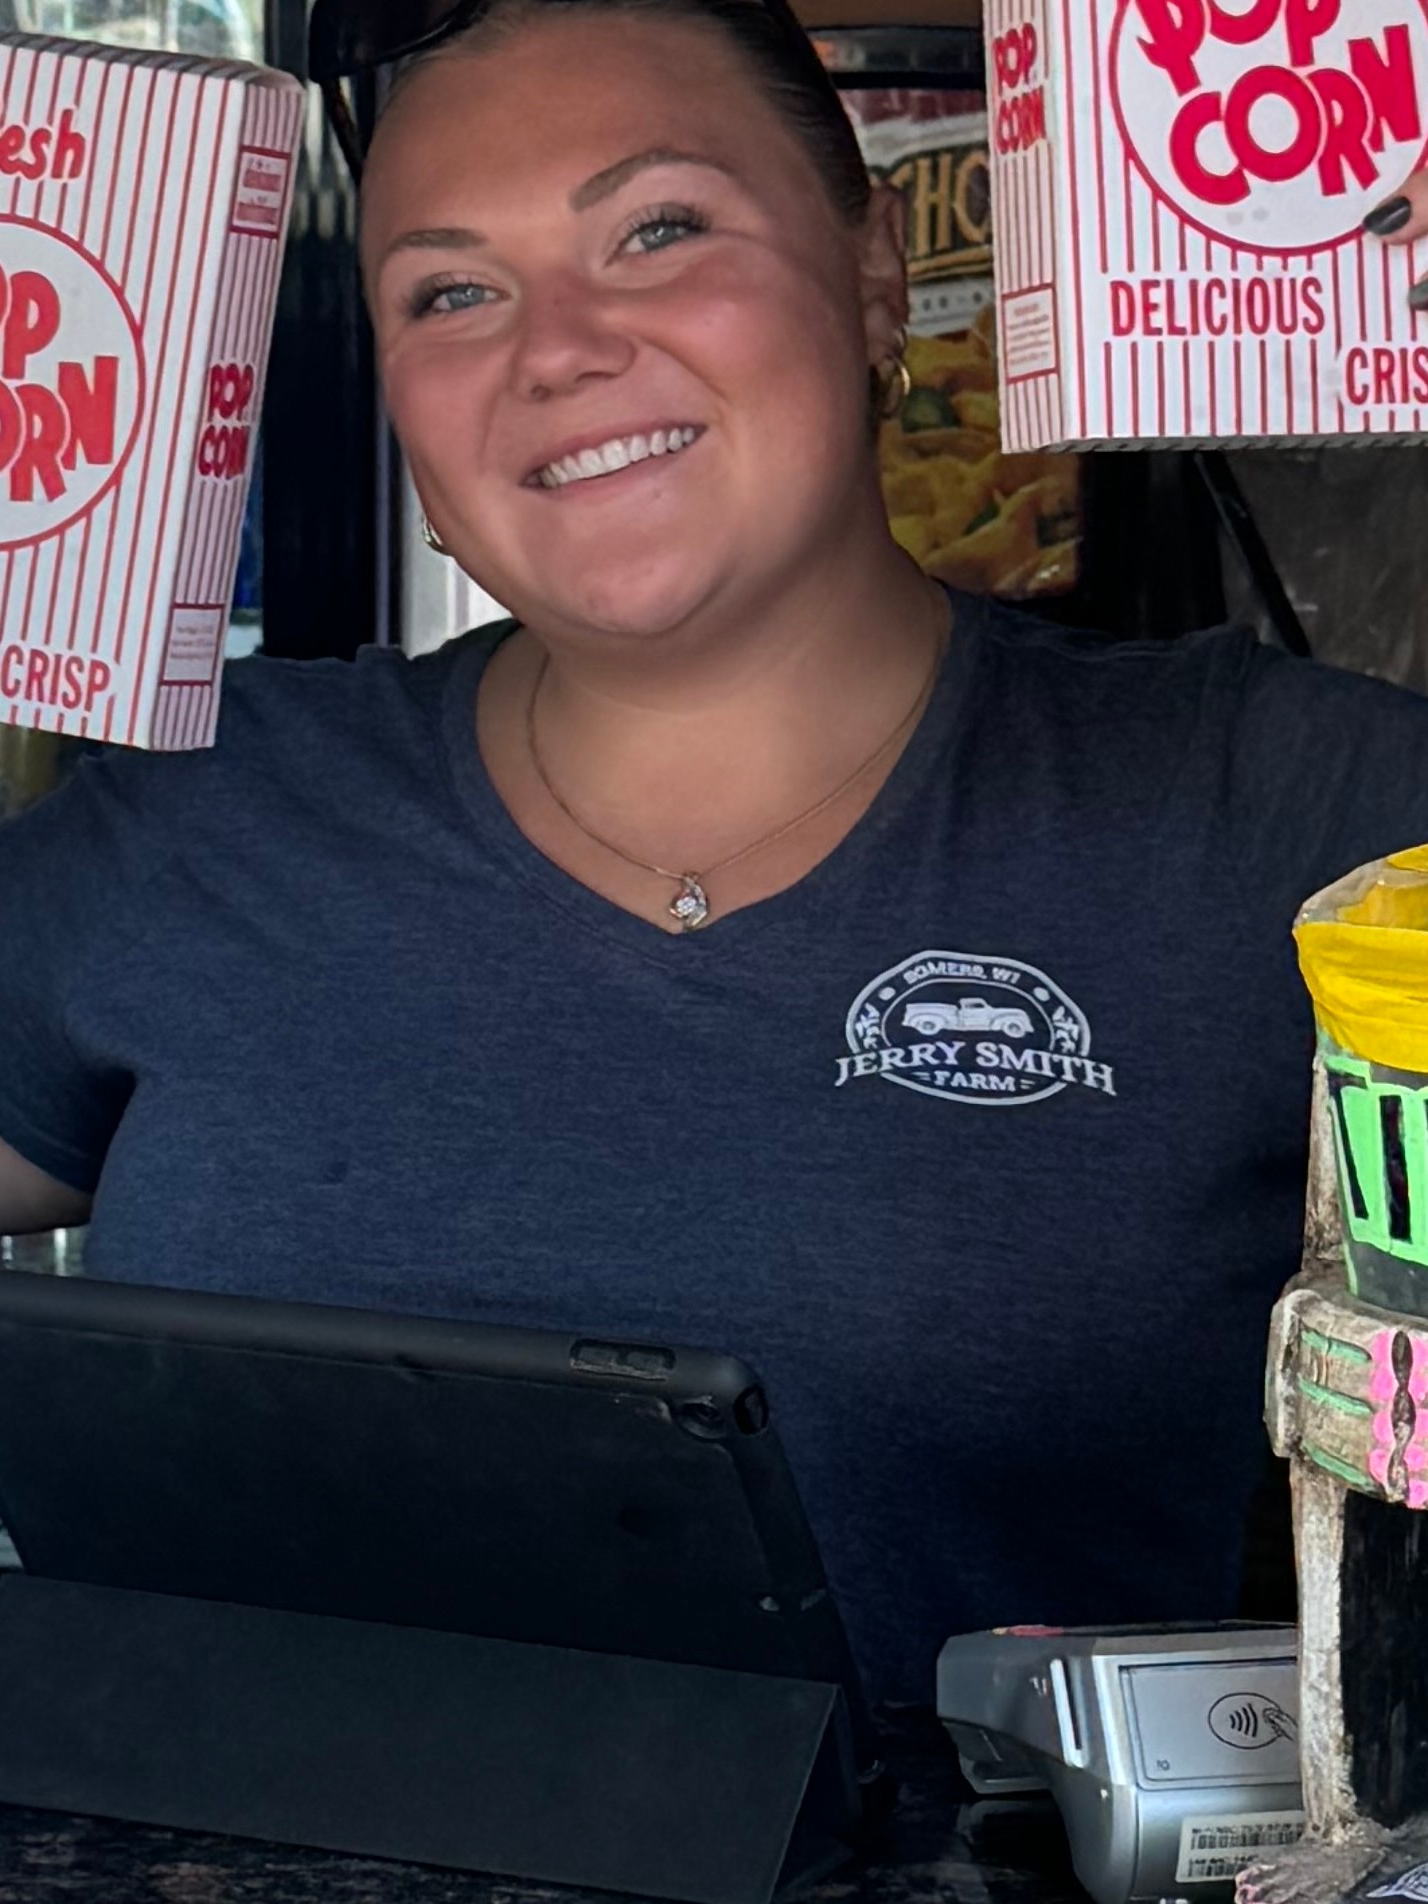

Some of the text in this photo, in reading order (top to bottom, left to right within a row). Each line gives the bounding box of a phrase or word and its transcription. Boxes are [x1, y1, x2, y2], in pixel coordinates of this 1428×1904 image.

[992, 22, 1038, 94] POP
[1171, 23, 1422, 206] CORN
[1110, 277, 1327, 338] DELICIOUS
[209, 363, 255, 419] POP
[0, 643, 112, 712] CRISP
[834, 1041, 1117, 1096] JERRY SMITH
[933, 1070, 1016, 1091] FARM
